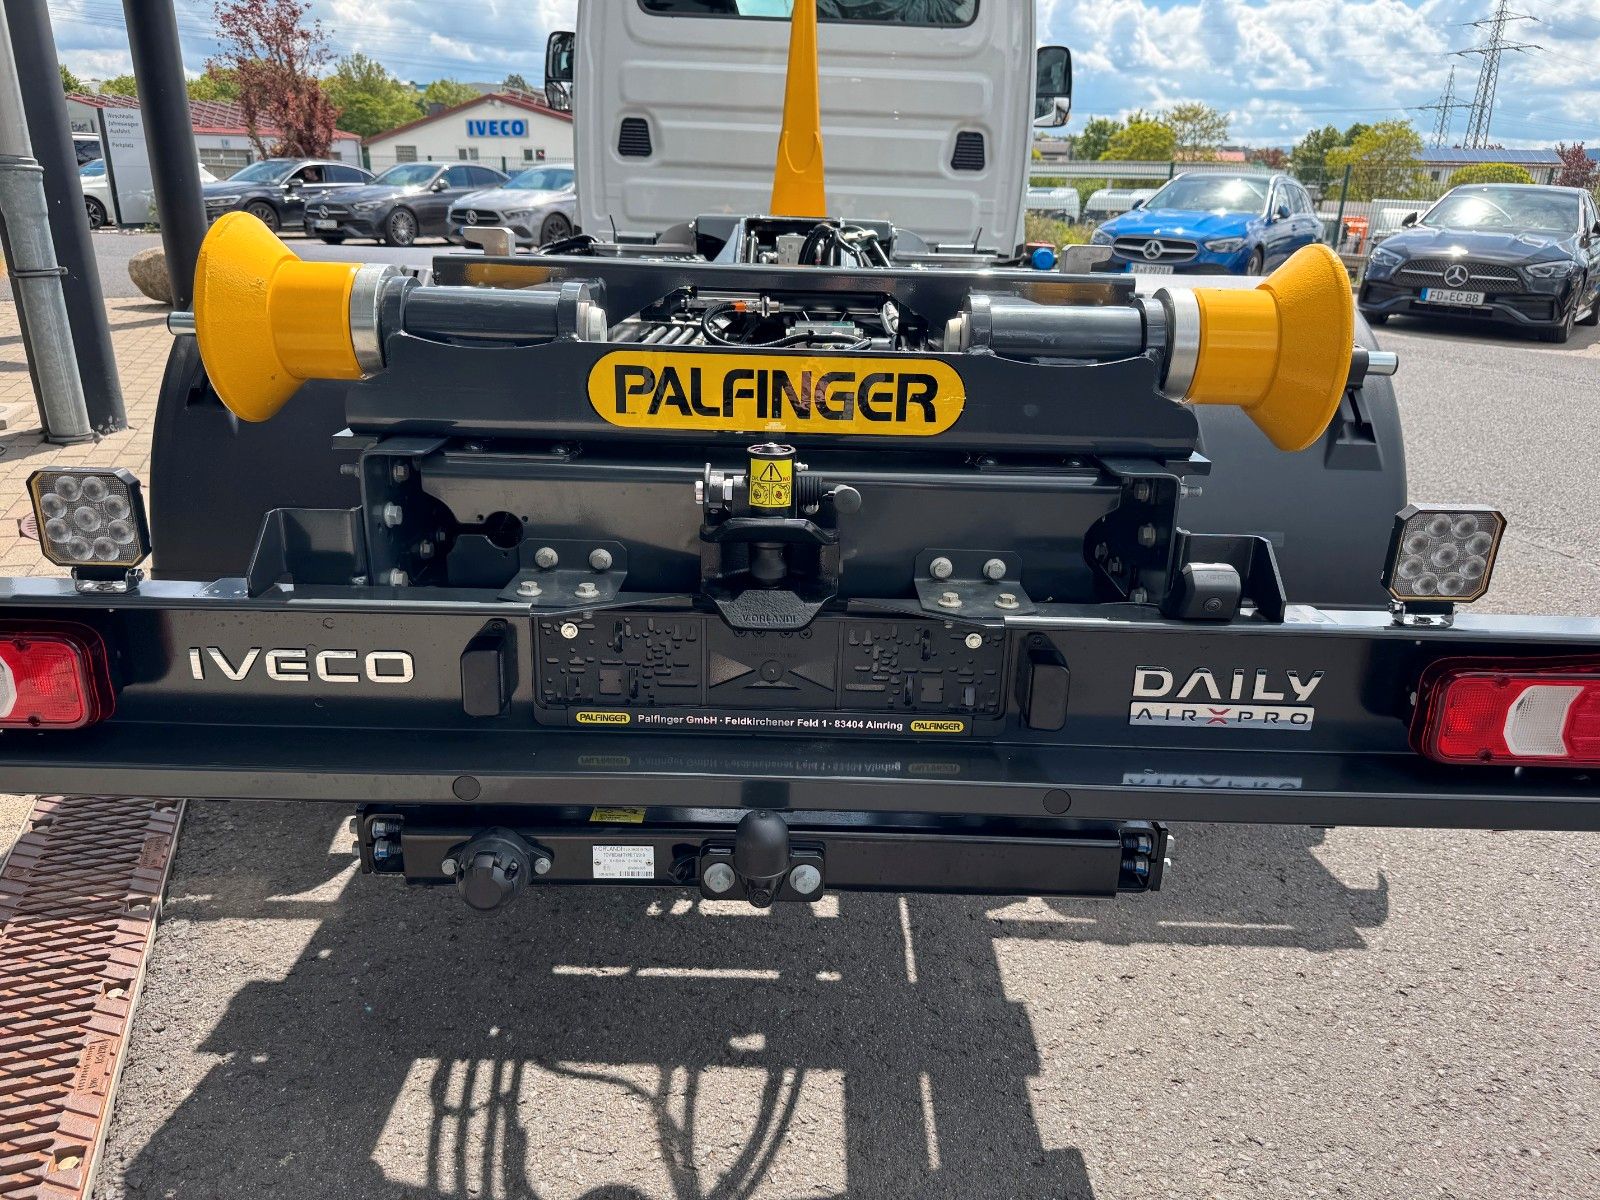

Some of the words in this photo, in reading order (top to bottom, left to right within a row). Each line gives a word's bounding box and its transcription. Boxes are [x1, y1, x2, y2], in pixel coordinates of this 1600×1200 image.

[467, 119, 525, 136] IVECO
[1466, 294, 1479, 303] 88
[614, 364, 938, 422] PALFINGER
[188, 646, 415, 684] IVECO
[1132, 665, 1325, 702] DAILY
[579, 713, 628, 722] PALFINGER
[638, 714, 683, 725] Palfinger
[686, 716, 718, 724] GmbH
[725, 717, 794, 727] Feldkirchener
[797, 718, 819, 728] Feld
[822, 719, 827, 728] 1
[834, 720, 864, 729] 83404
[865, 721, 903, 731] Ainring
[913, 722, 962, 731] PALFINGER
